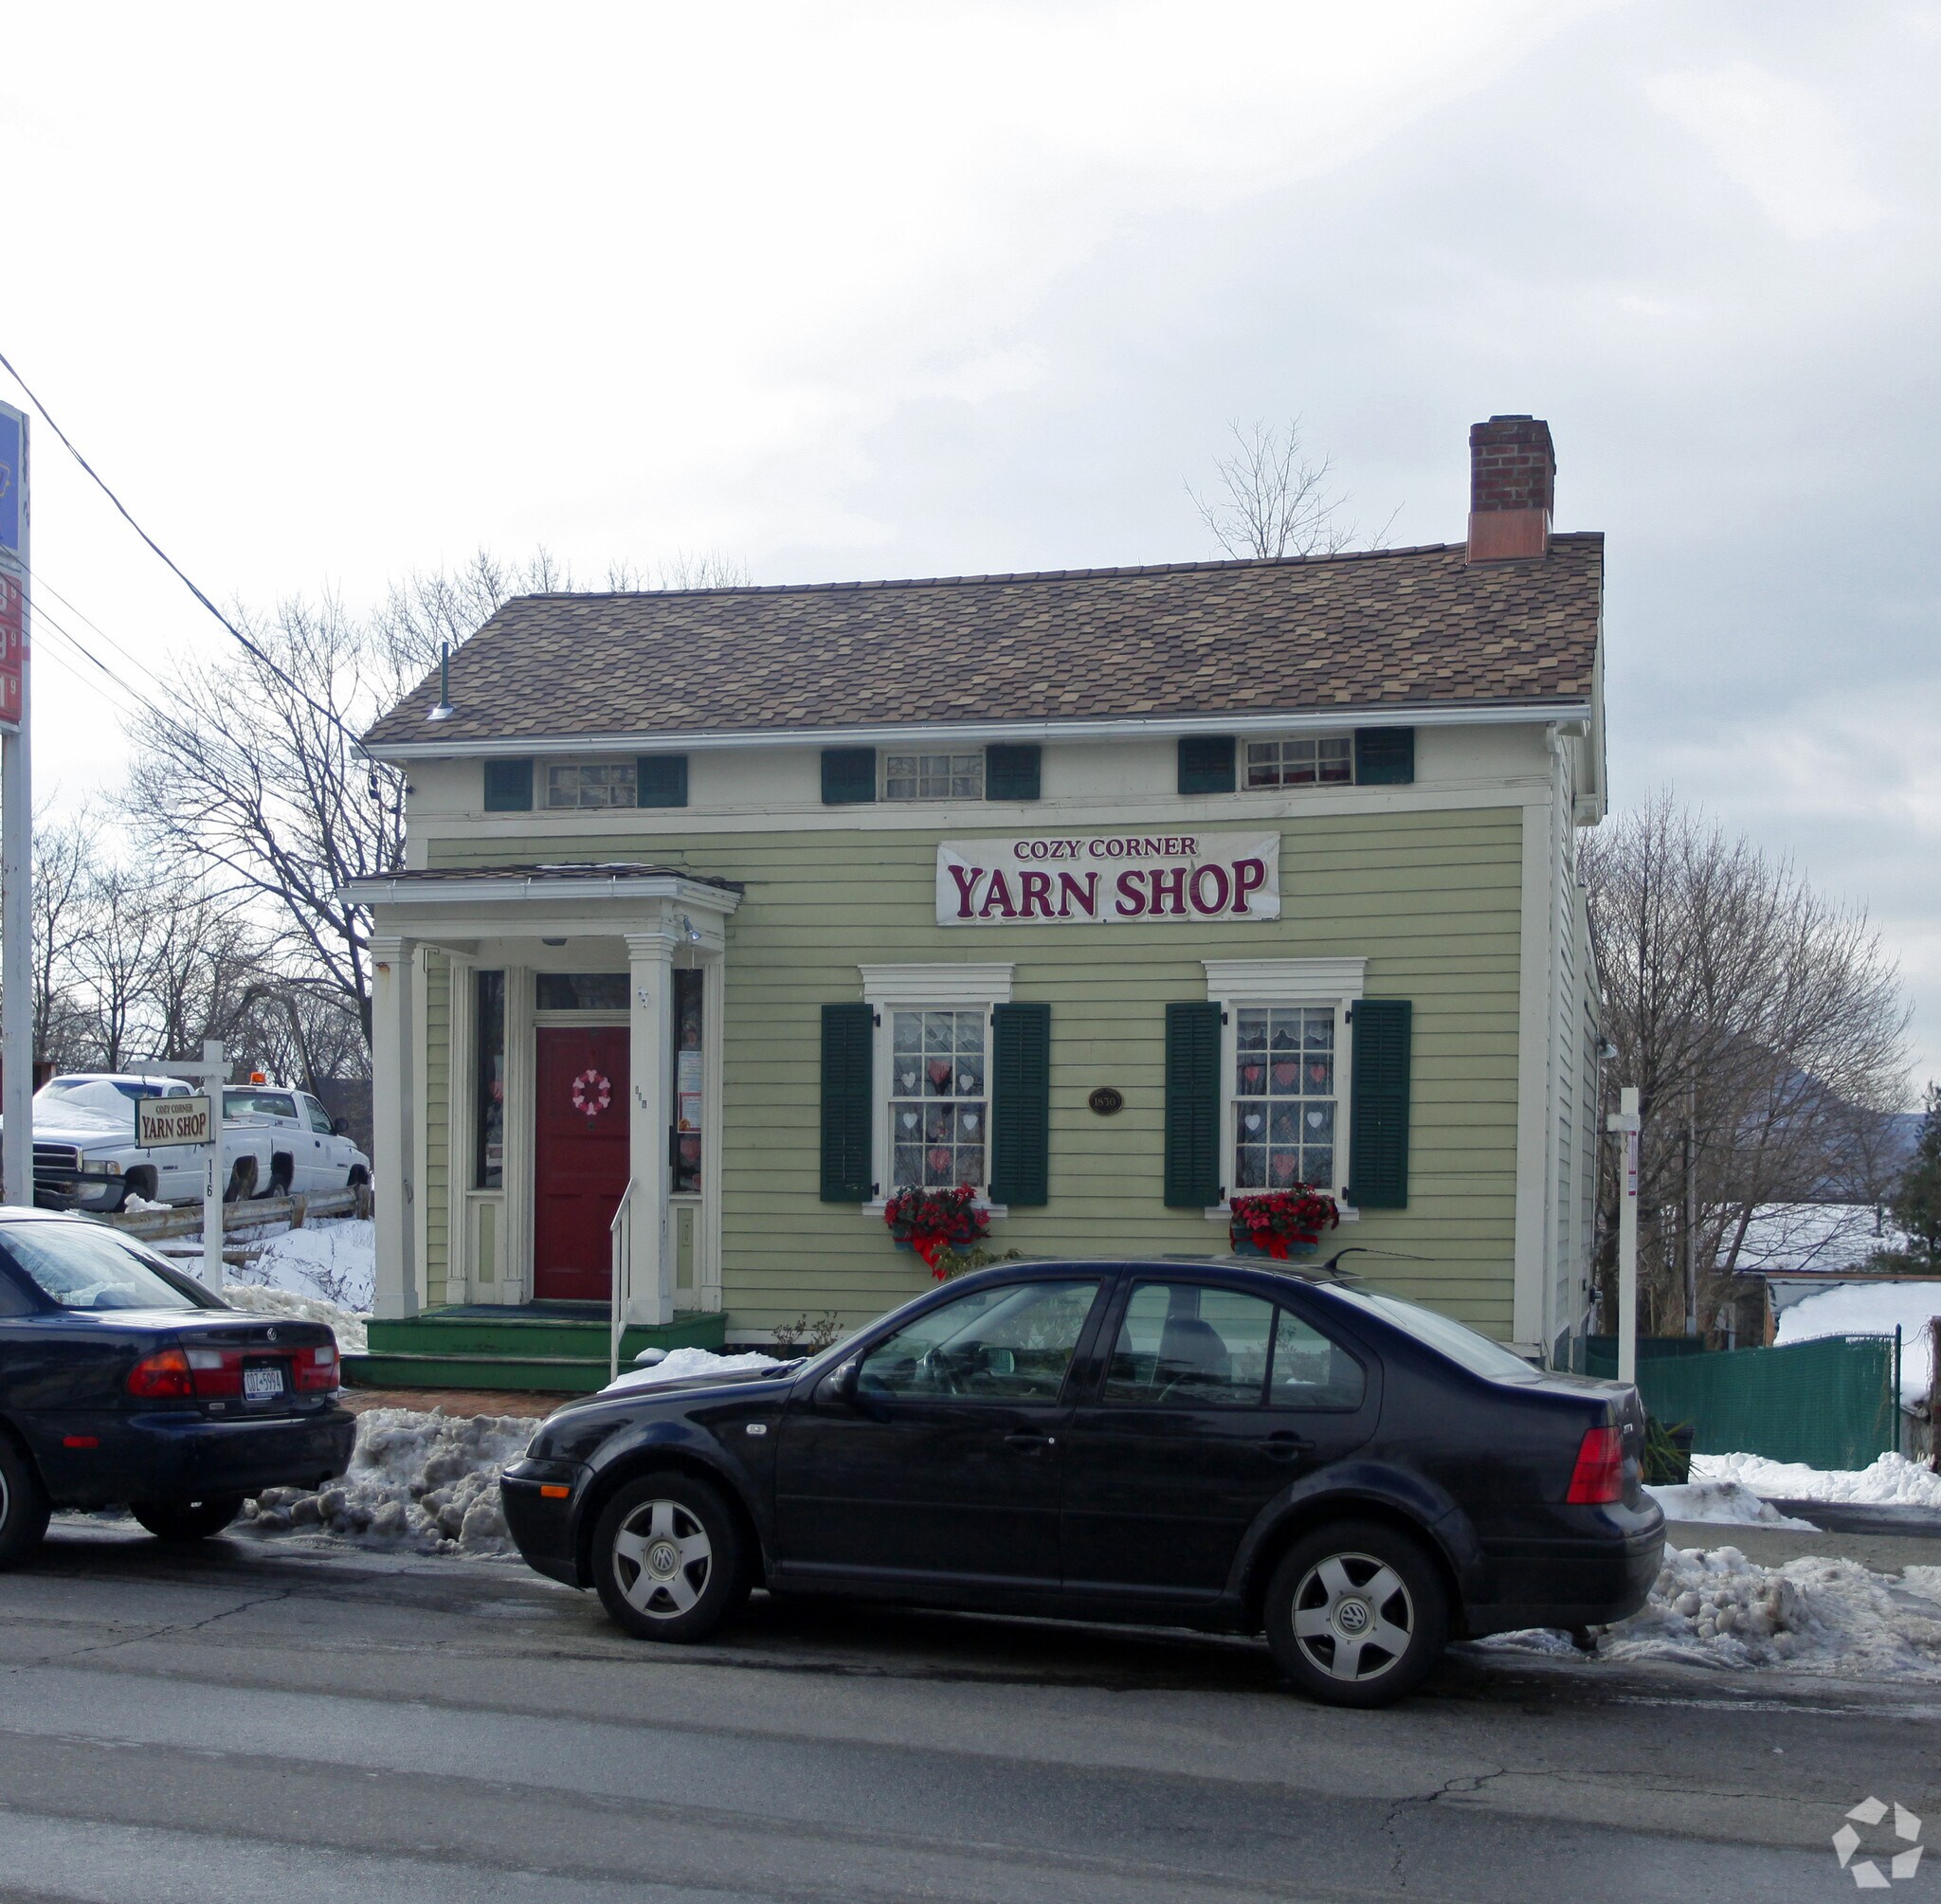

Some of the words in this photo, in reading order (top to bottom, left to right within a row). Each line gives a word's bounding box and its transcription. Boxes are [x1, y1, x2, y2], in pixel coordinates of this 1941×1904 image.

[1013, 840, 1081, 860] COZY
[1088, 836, 1198, 859] CORNER
[947, 863, 1100, 918] YARN
[1115, 858, 1266, 917] SHOP
[155, 1104, 171, 1115] COZY
[171, 1103, 194, 1114] CORNER
[142, 1115, 174, 1140] YARN
[176, 1112, 207, 1137] SHOP
